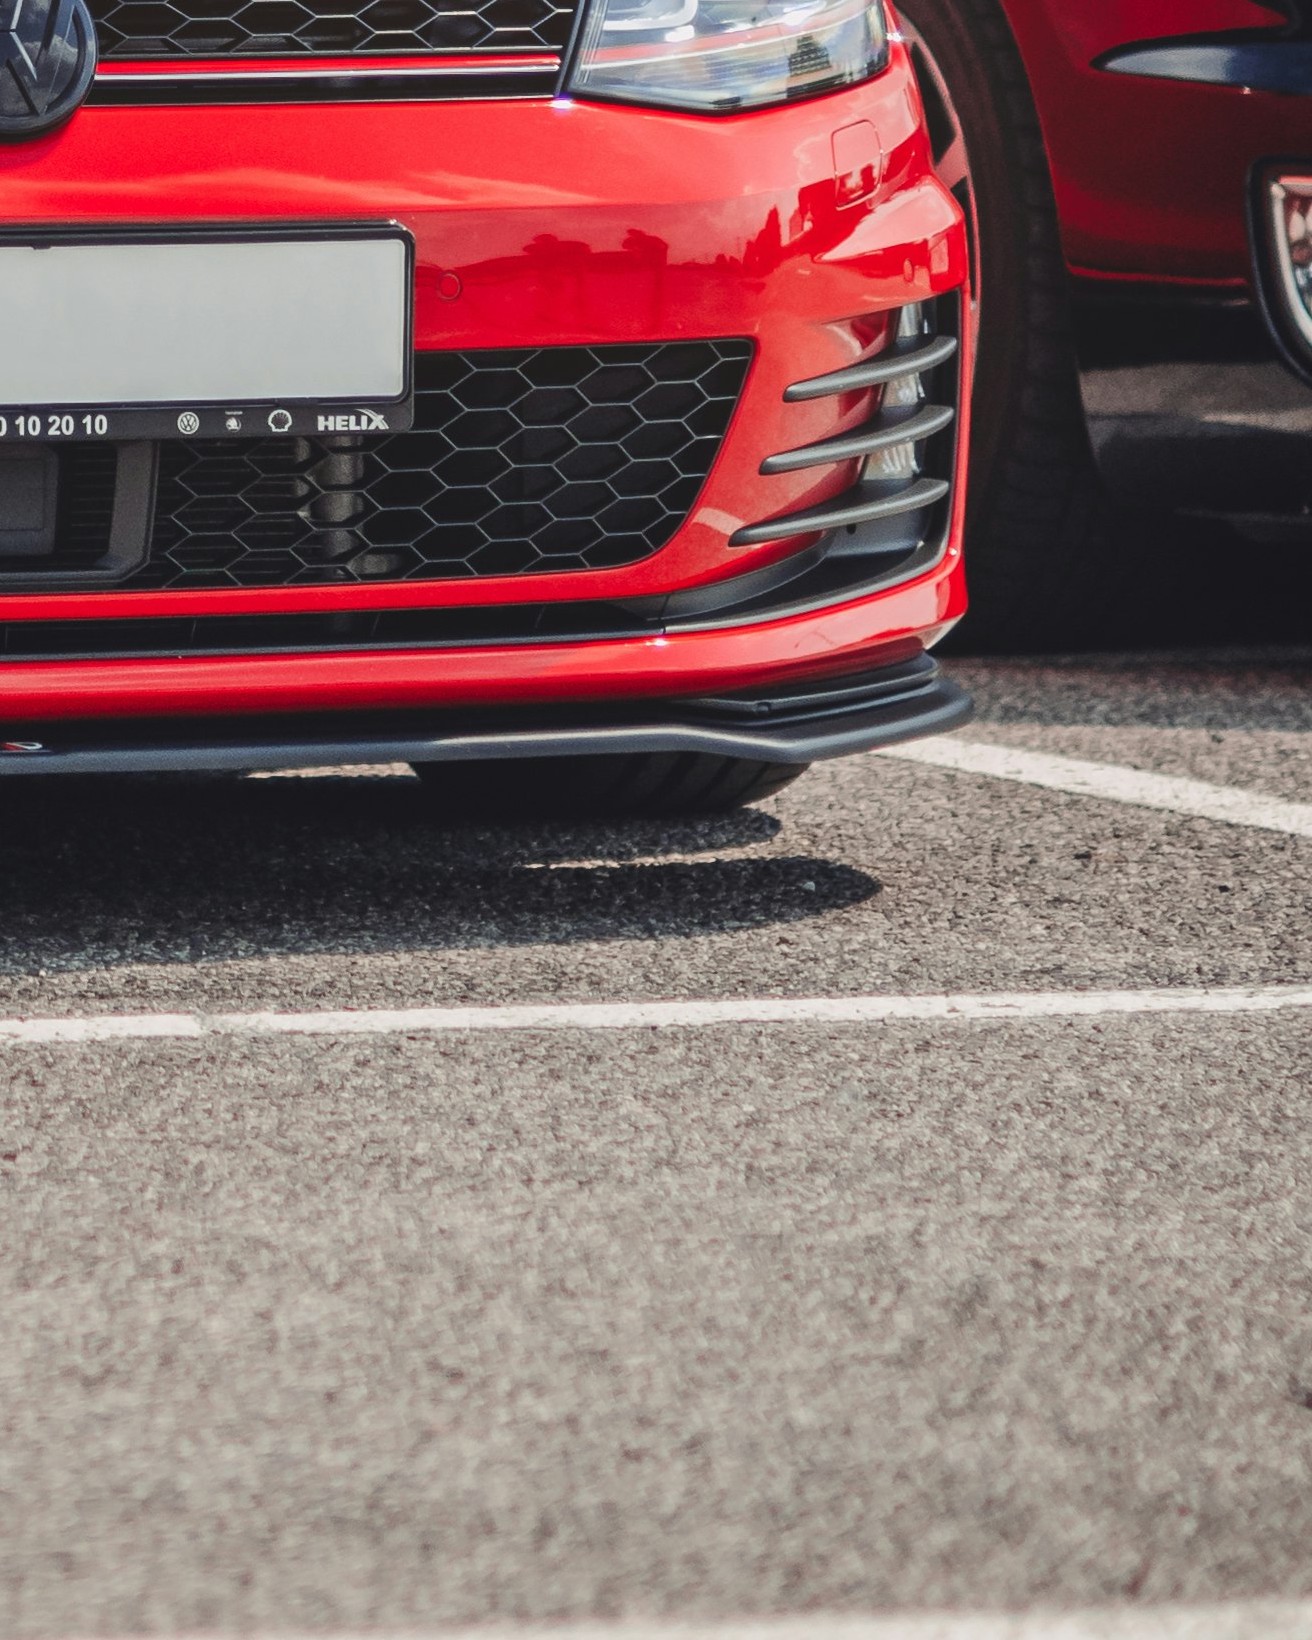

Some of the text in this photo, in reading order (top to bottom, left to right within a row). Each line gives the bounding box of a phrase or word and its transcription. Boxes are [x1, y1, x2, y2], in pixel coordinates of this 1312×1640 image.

[15, 415, 42, 437] 10
[47, 415, 75, 436] 20
[81, 414, 108, 435] 10
[317, 409, 390, 432] HELIX
